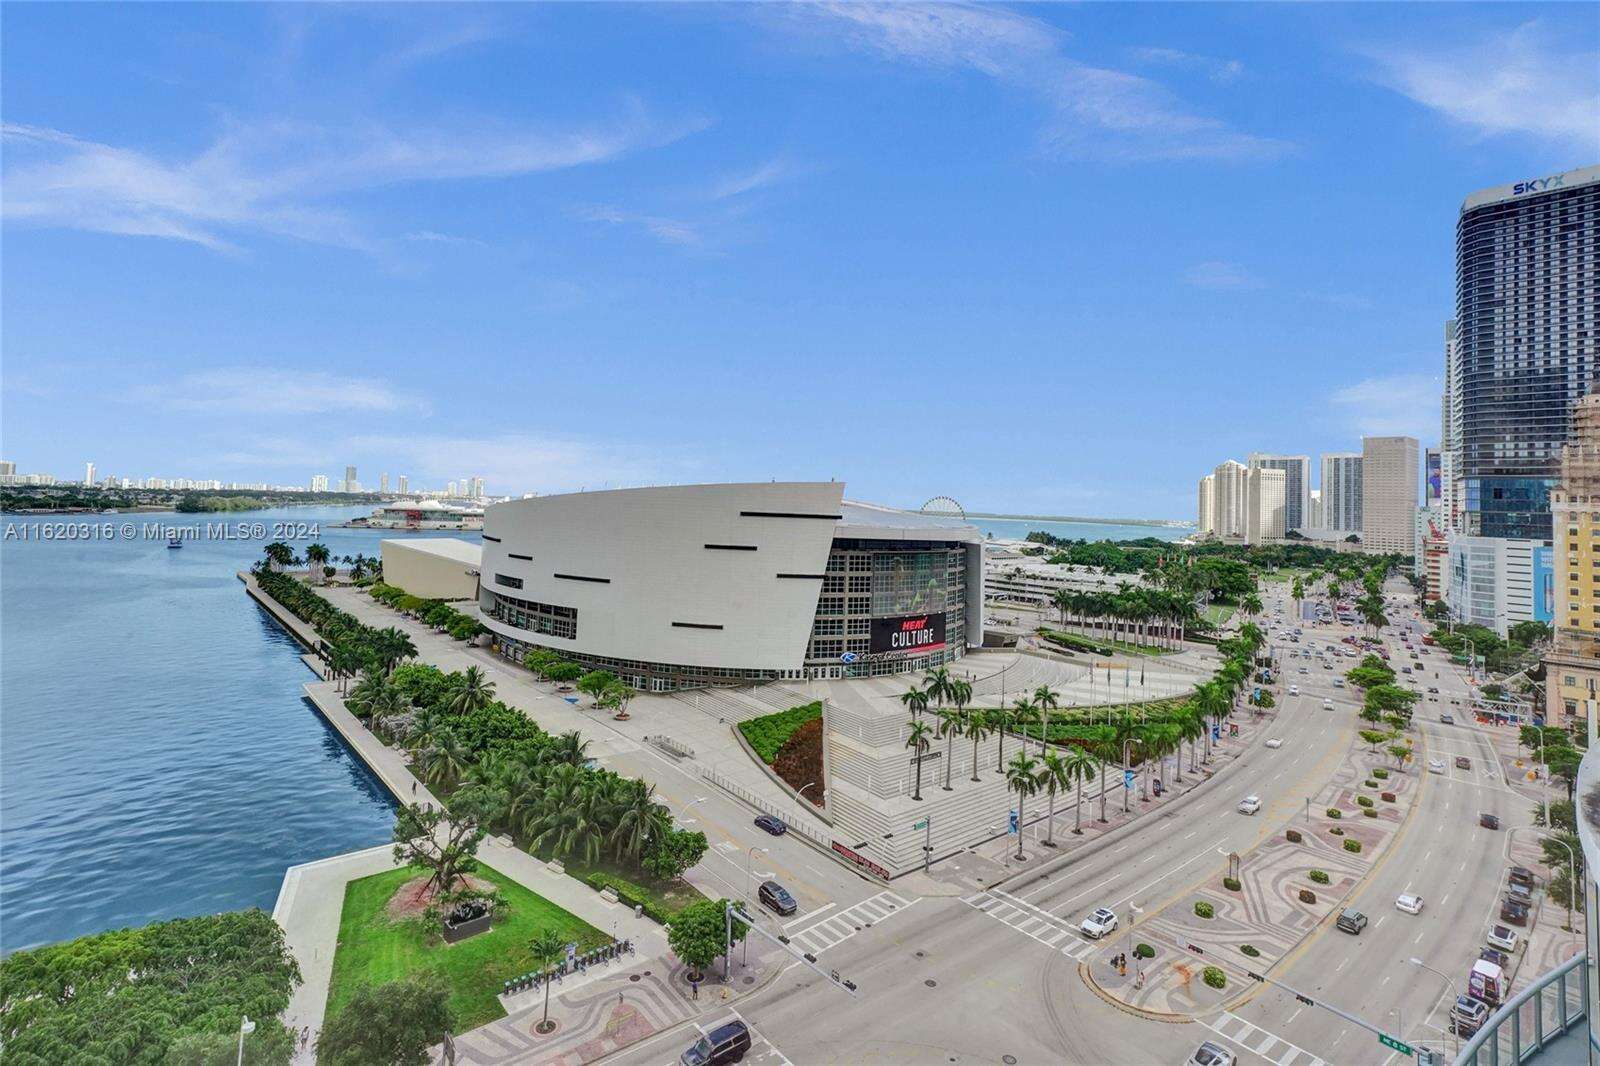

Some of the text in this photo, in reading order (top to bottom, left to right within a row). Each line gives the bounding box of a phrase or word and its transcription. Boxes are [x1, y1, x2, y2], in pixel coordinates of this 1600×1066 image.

[1513, 174, 1565, 195] SKYX
[902, 616, 928, 629] HEAT
[892, 628, 934, 647] CULTURE
